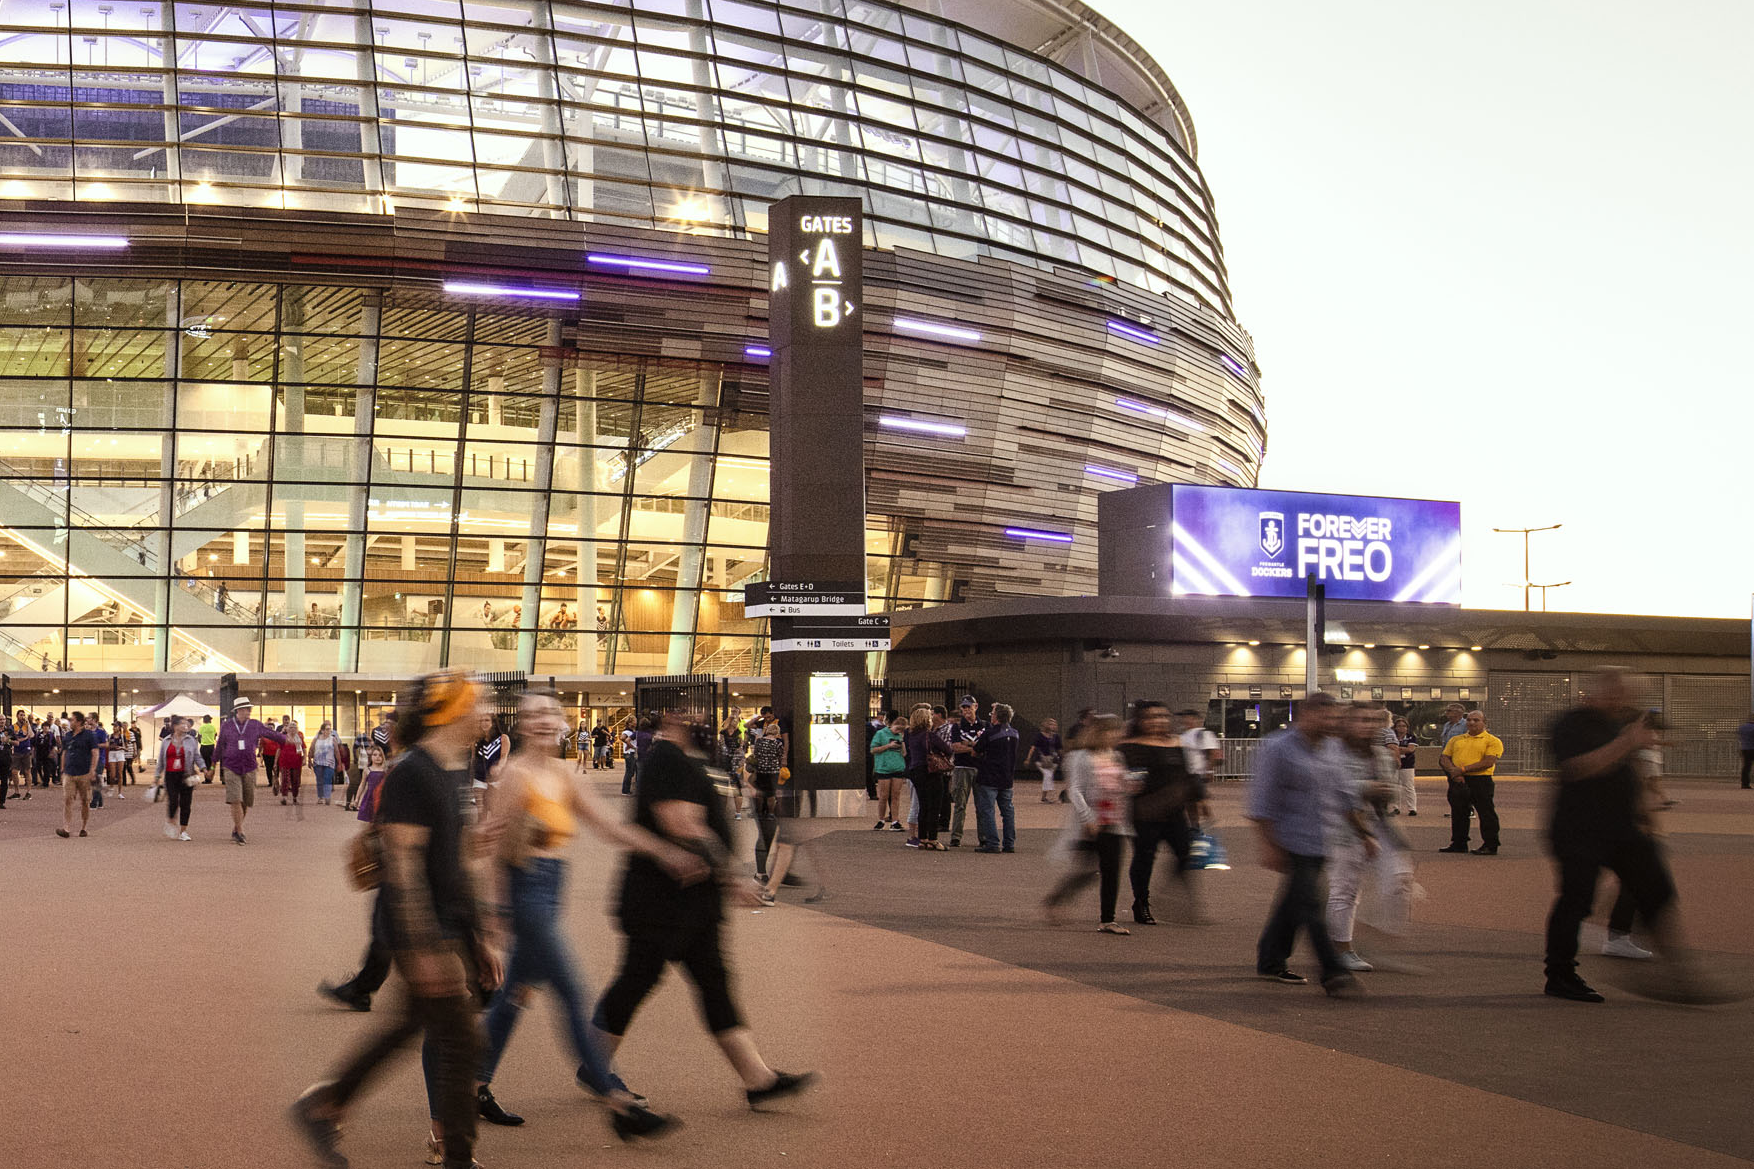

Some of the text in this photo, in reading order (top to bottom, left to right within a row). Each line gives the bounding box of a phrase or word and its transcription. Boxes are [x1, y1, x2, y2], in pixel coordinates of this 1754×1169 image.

[800, 215, 853, 234] GATES
[812, 238, 842, 278] A
[772, 261, 788, 292] A
[813, 288, 841, 328] B
[1298, 513, 1392, 541] FOREVER
[1298, 538, 1393, 582] FREO
[1251, 566, 1293, 578] DOCKERS
[779, 583, 799, 591] Gates
[780, 595, 845, 604] Matagarup Bridge
[788, 606, 801, 614] Bus
[832, 640, 854, 648] Toilets
